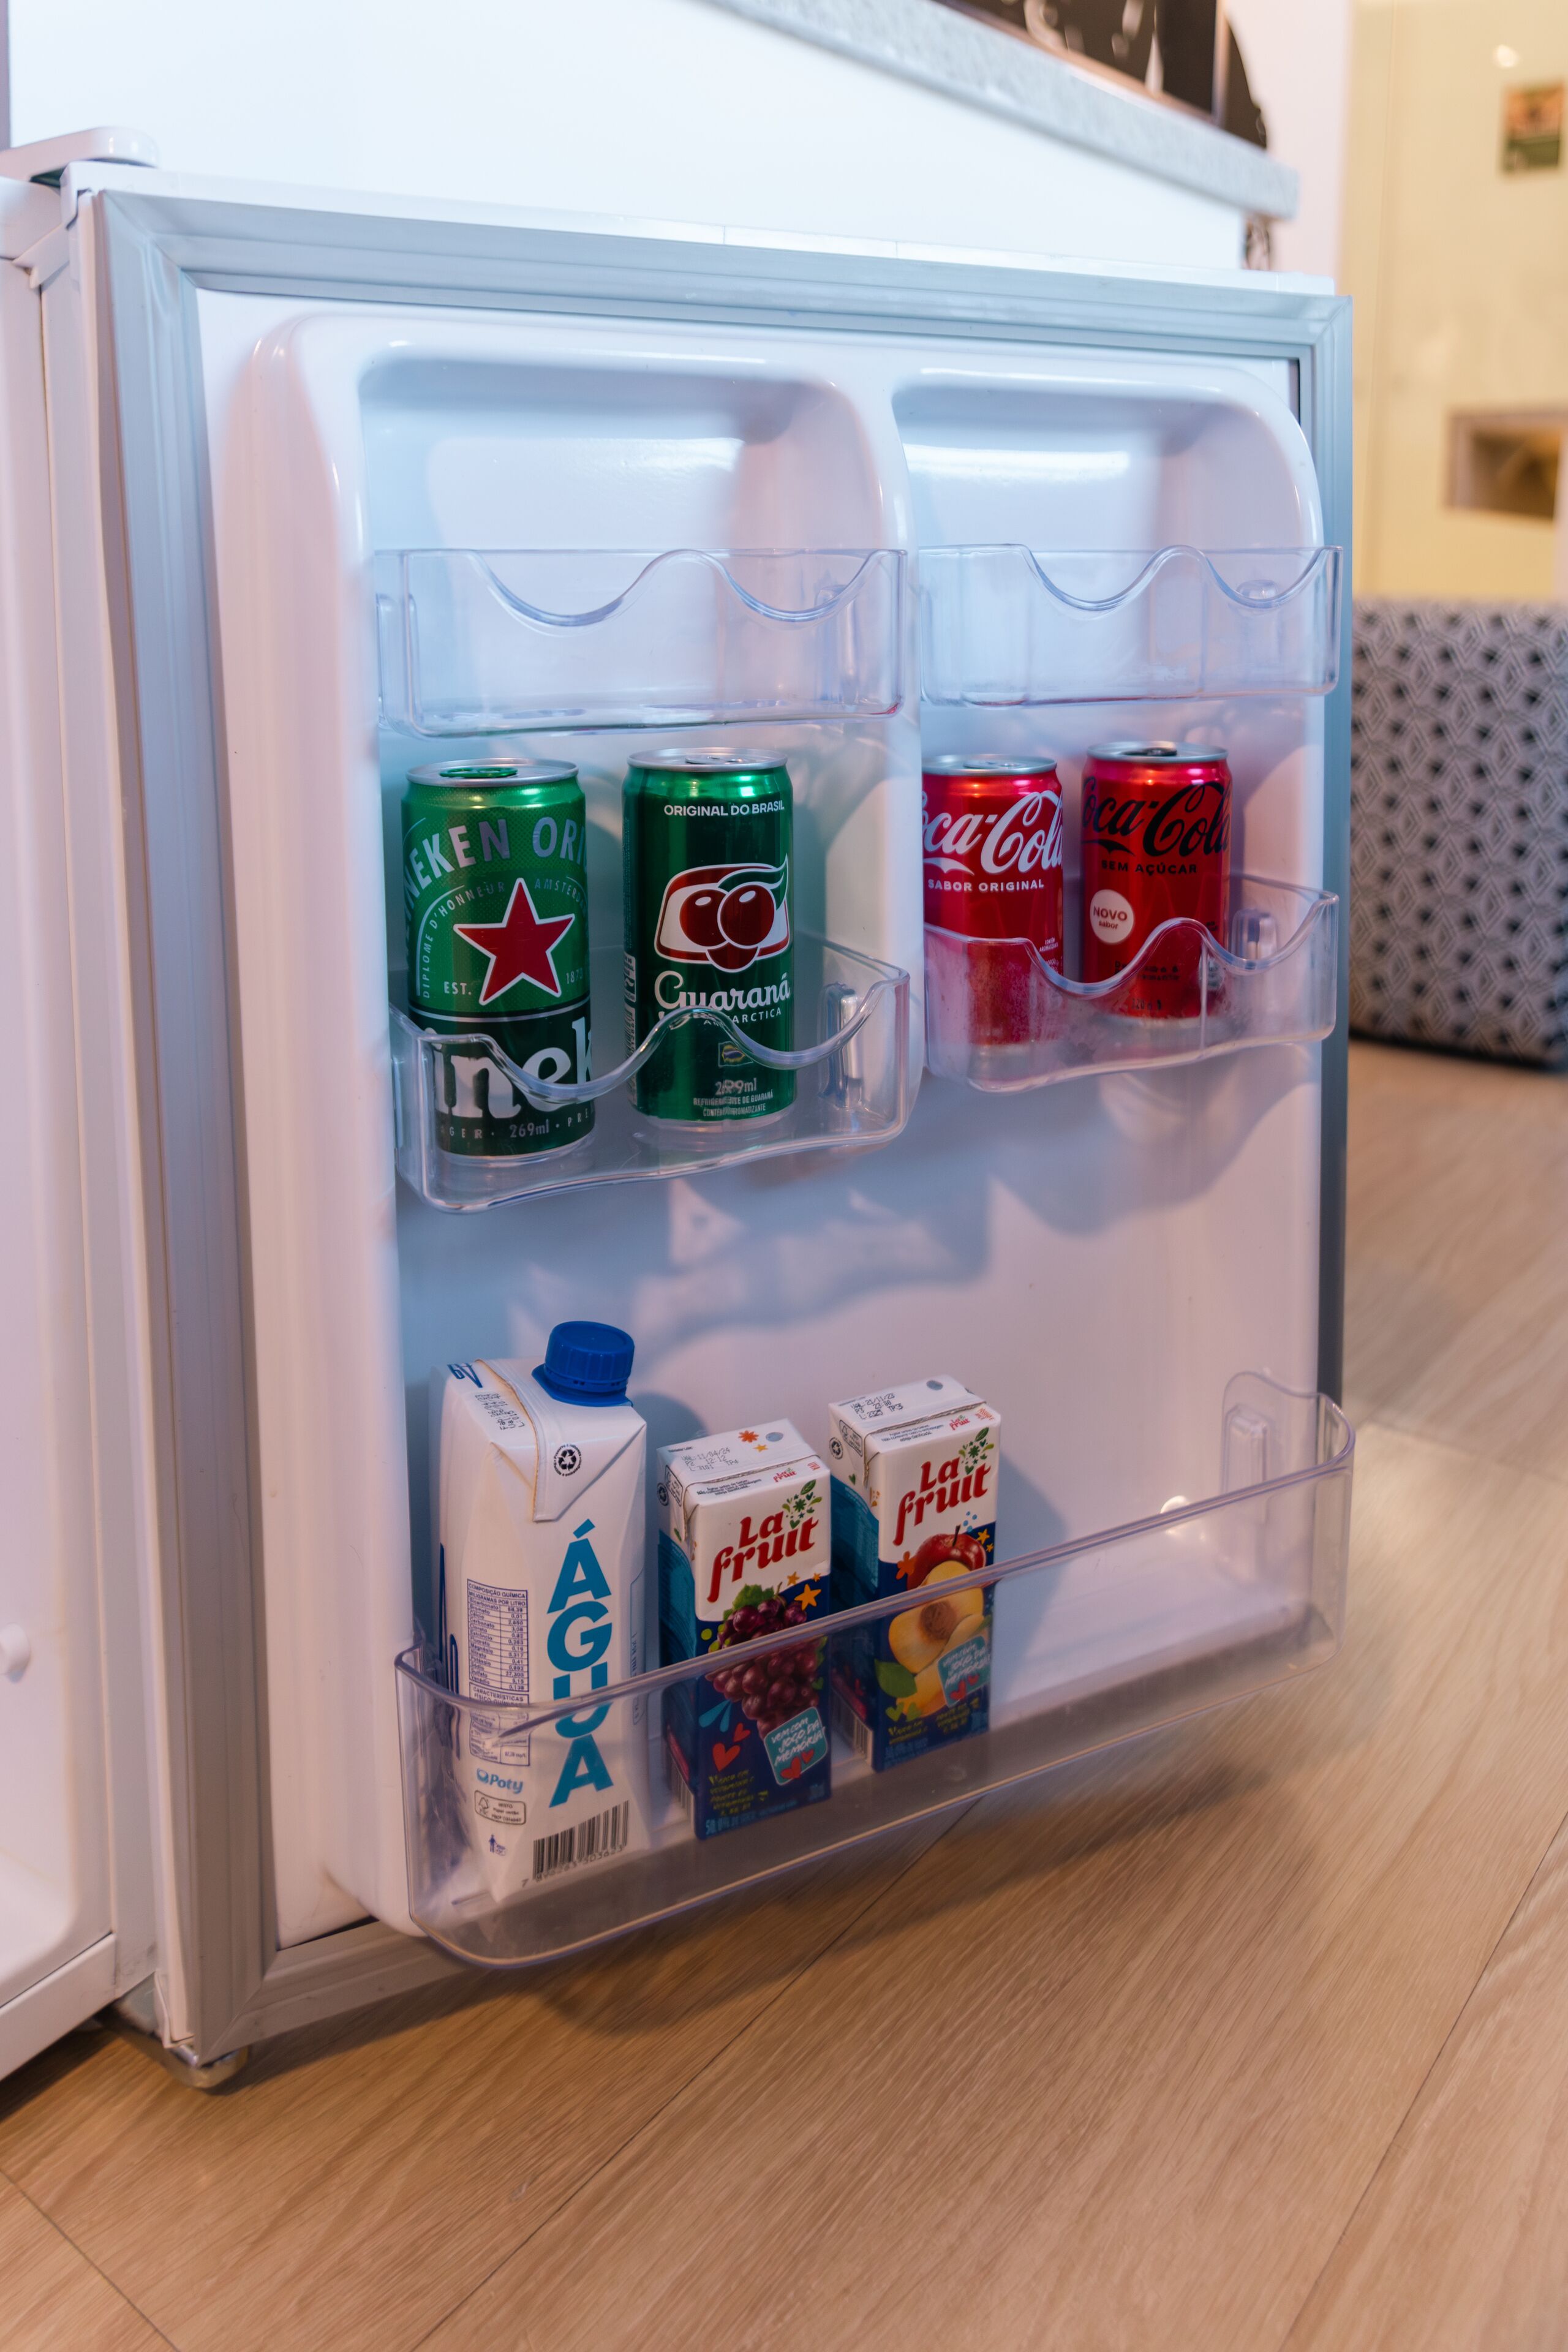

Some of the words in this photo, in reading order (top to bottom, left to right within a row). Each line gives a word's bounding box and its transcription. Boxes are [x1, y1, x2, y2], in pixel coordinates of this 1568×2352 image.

[664, 804, 728, 816] ORIGINAL
[730, 804, 750, 816] DO
[752, 799, 785, 814] BRASIL
[1101, 860, 1128, 872] SEM
[1135, 862, 1197, 876] AÇÚCAR
[928, 879, 972, 891] SABOR
[978, 879, 1044, 892] ORIGINAL
[1093, 905, 1128, 921] NOVO
[1099, 920, 1118, 930] sabor
[422, 934, 434, 999] DIPLOME
[429, 881, 505, 929] D'HONNEUR
[443, 981, 472, 995] EST.
[654, 970, 791, 1016] Guaraná
[751, 1089, 774, 1102] GUARANÁ
[509, 1118, 550, 1138] 269ml
[920, 1457, 960, 1494] La
[892, 1463, 991, 1547] fruit
[738, 1511, 784, 1549] La
[707, 1517, 819, 1604] fruit
[468, 1583, 500, 1596] COMPOSIÇÃO
[547, 1519, 614, 1808] ÁGUA
[490, 1773, 524, 1794] Poty
